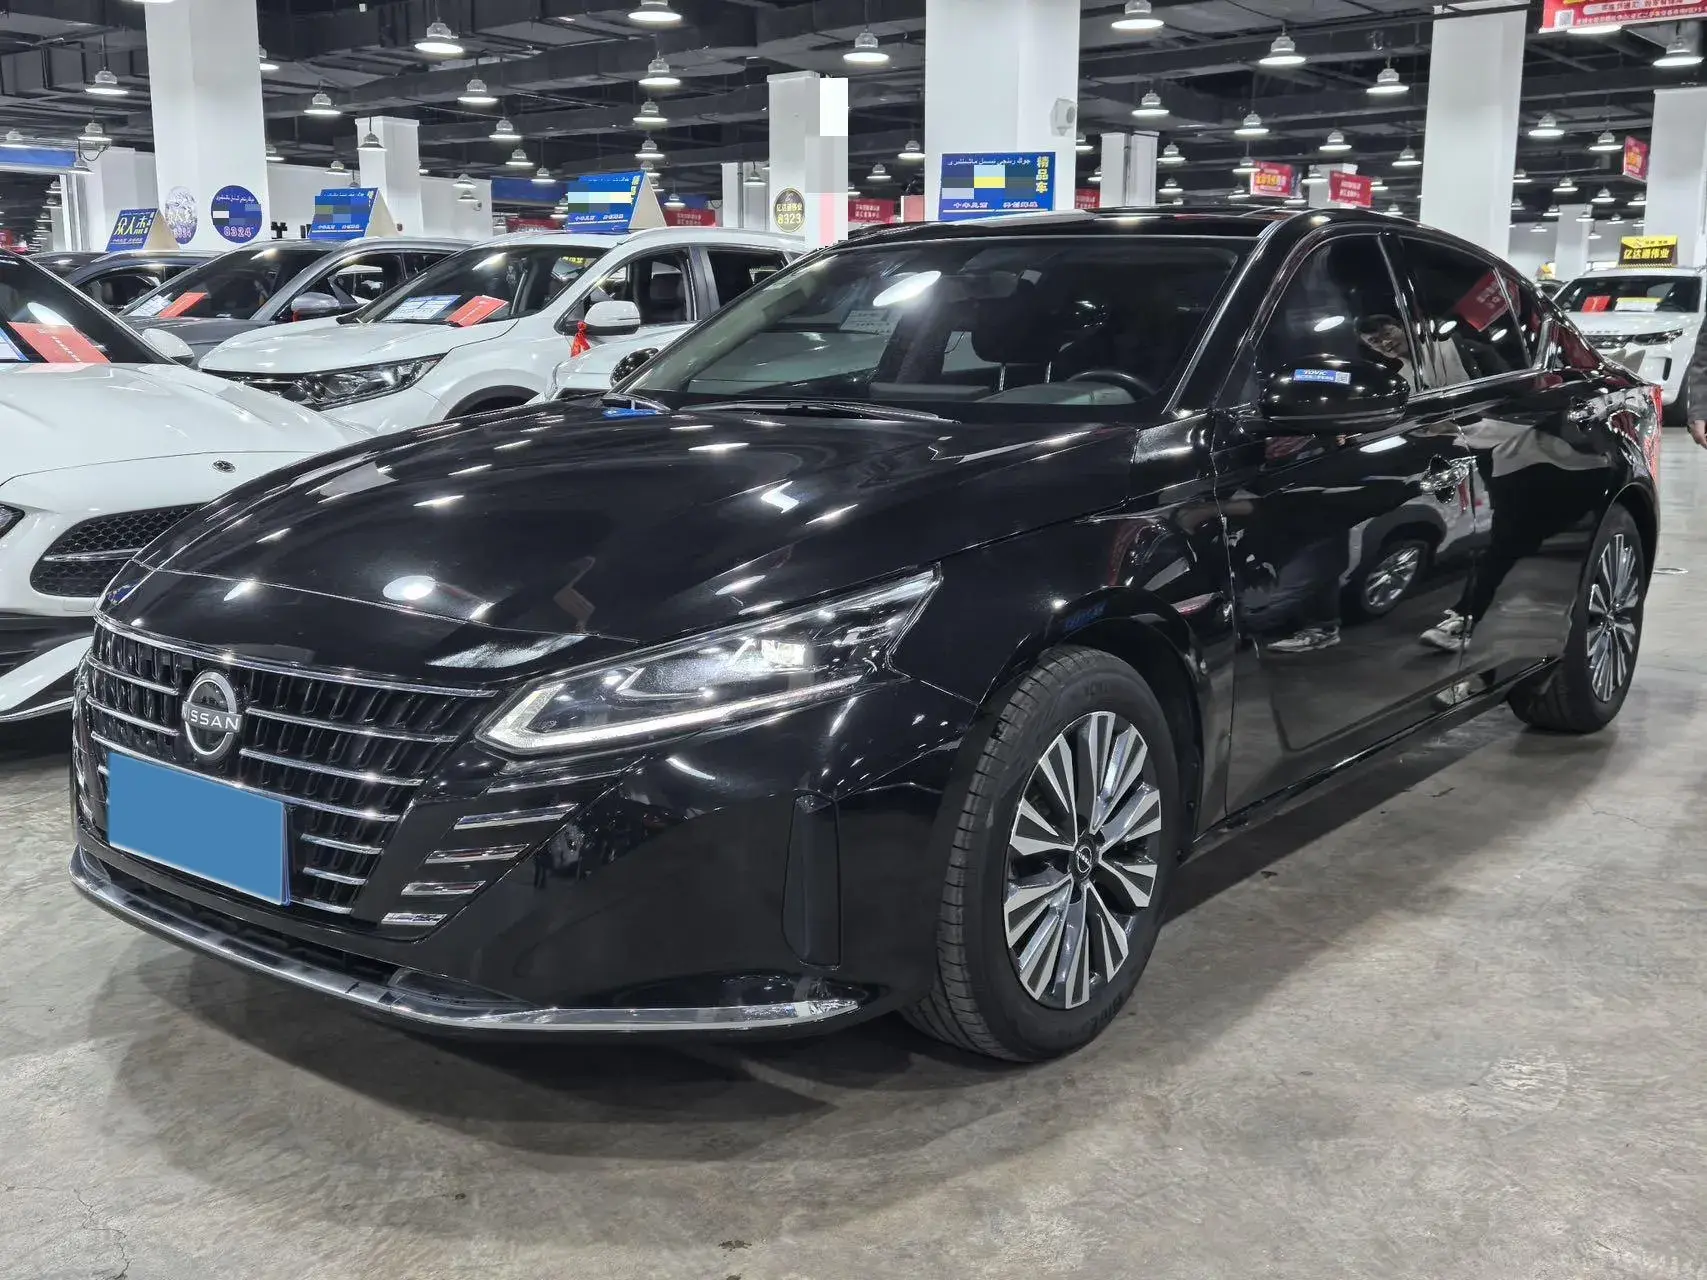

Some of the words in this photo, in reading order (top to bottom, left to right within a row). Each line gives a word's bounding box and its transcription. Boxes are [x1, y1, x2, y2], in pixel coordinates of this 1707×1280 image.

[1035, 156, 1050, 193] 精品车
[777, 213, 802, 224] 8323
[223, 225, 252, 238] 8324
